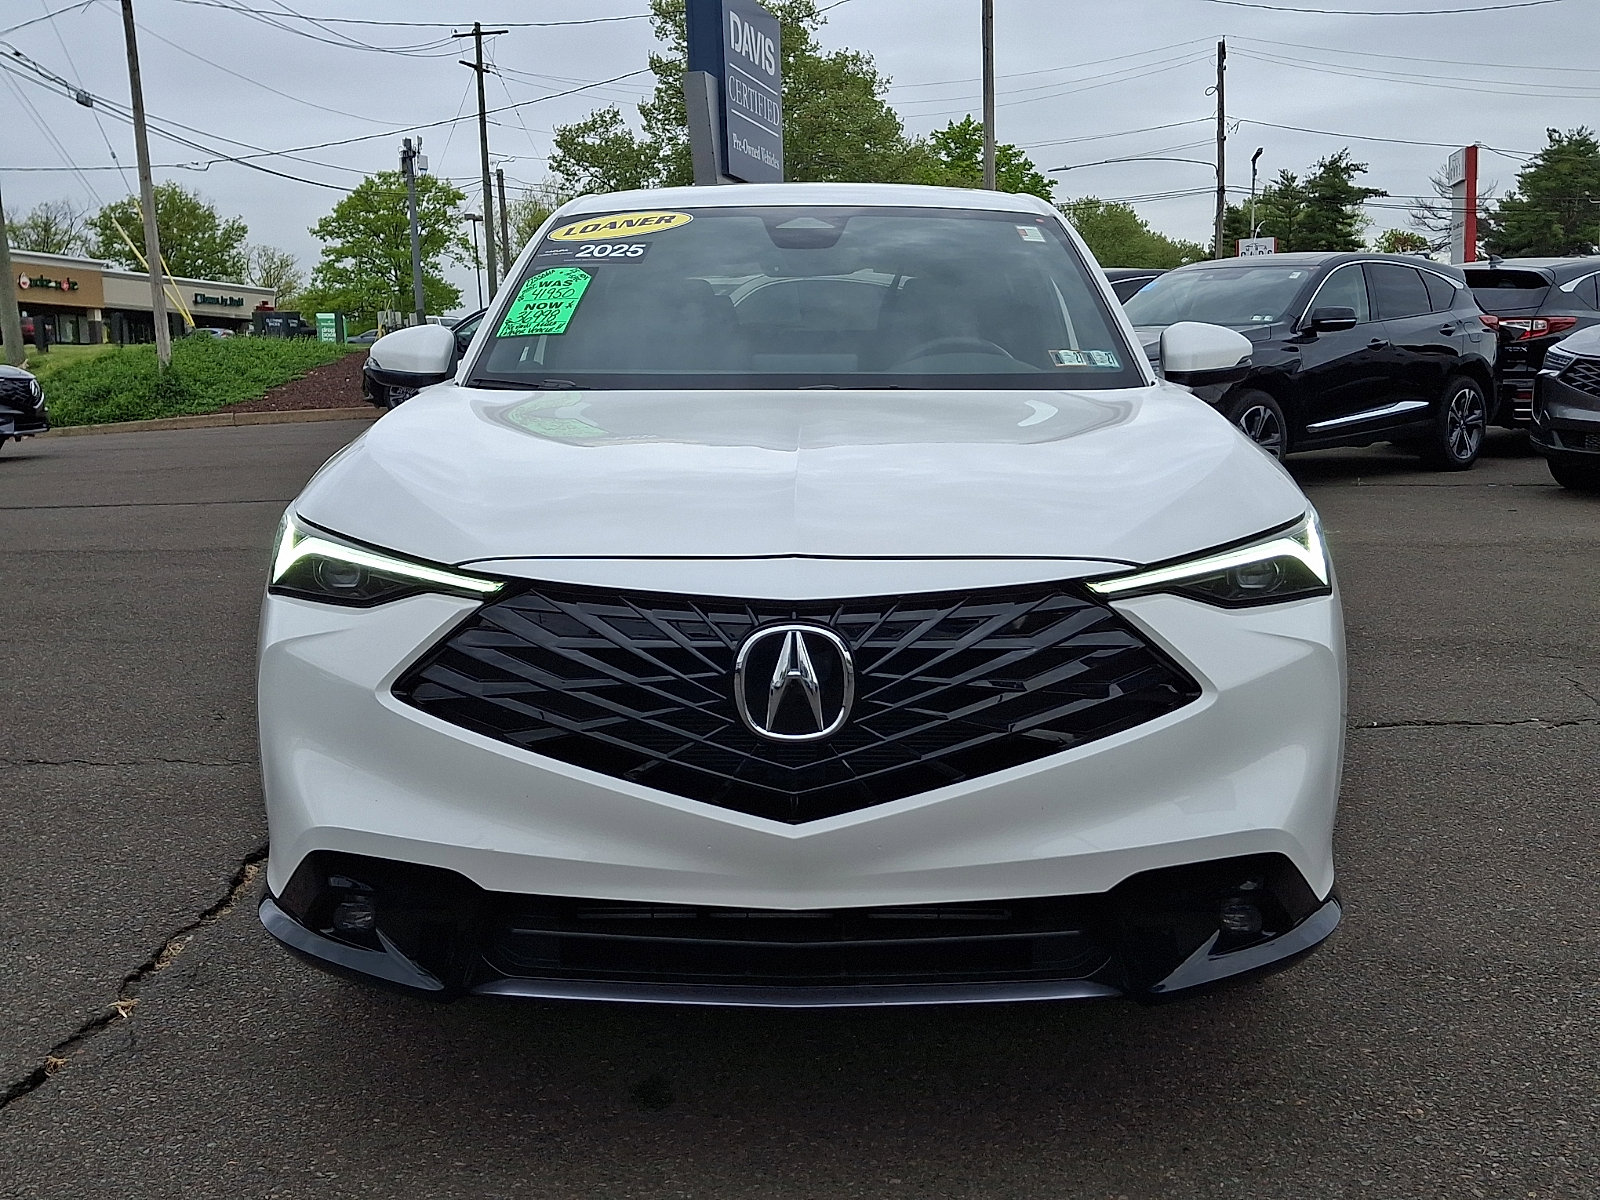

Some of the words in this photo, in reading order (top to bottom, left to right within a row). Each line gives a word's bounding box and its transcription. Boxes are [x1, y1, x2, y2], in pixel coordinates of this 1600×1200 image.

[729, 10, 775, 76] DAVIS
[728, 75, 780, 126] CERTIFIED
[732, 132, 761, 161] Pre-Owned
[760, 146, 780, 170] Vehicles
[562, 215, 677, 237] LOANER
[575, 244, 646, 258] 2025
[538, 280, 573, 288] WAS
[531, 287, 575, 300] 41950
[523, 302, 564, 310] NOW
[516, 309, 561, 323] 36998
